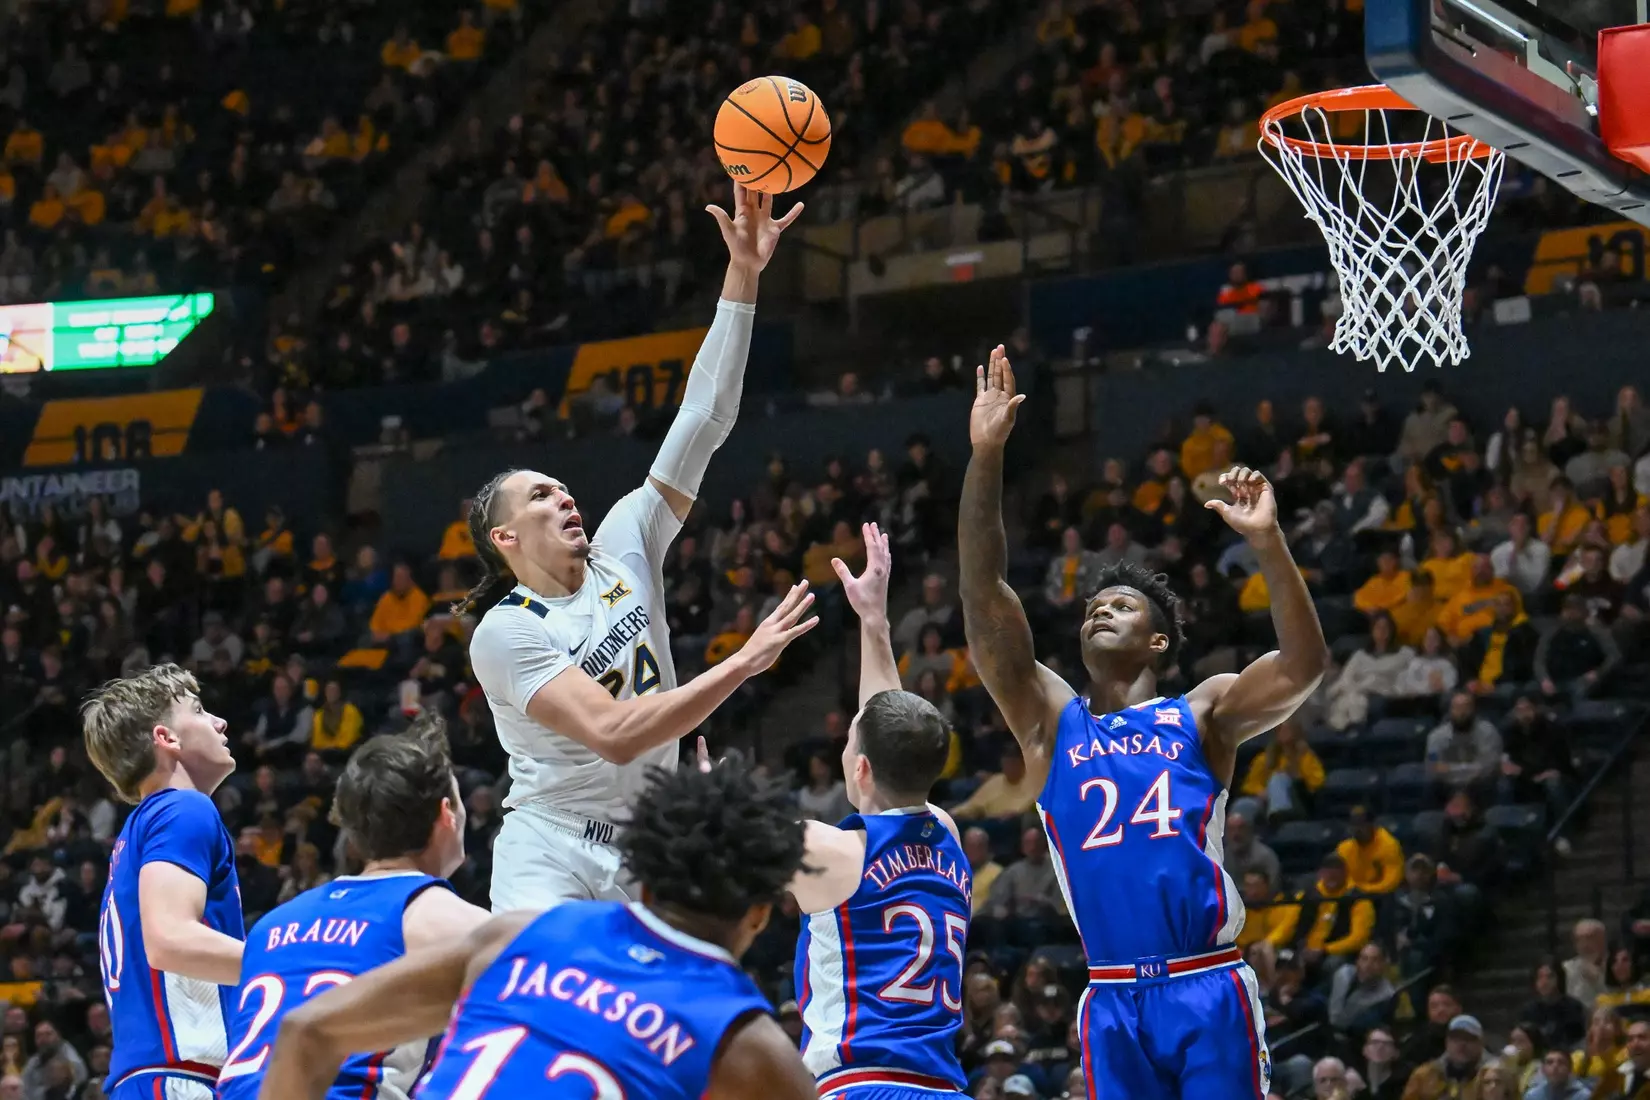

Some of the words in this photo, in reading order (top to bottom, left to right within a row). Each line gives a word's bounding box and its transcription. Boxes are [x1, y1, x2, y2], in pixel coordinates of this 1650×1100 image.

[1067, 734, 1184, 768] KANSAS
[583, 819, 614, 844] WVU
[1080, 768, 1182, 850] 24
[864, 844, 972, 902] TIMBERLAK
[265, 918, 369, 951] BRAUN
[877, 900, 969, 1012] 25
[1141, 963, 1161, 978] KU
[497, 957, 696, 1066] JACKSON
